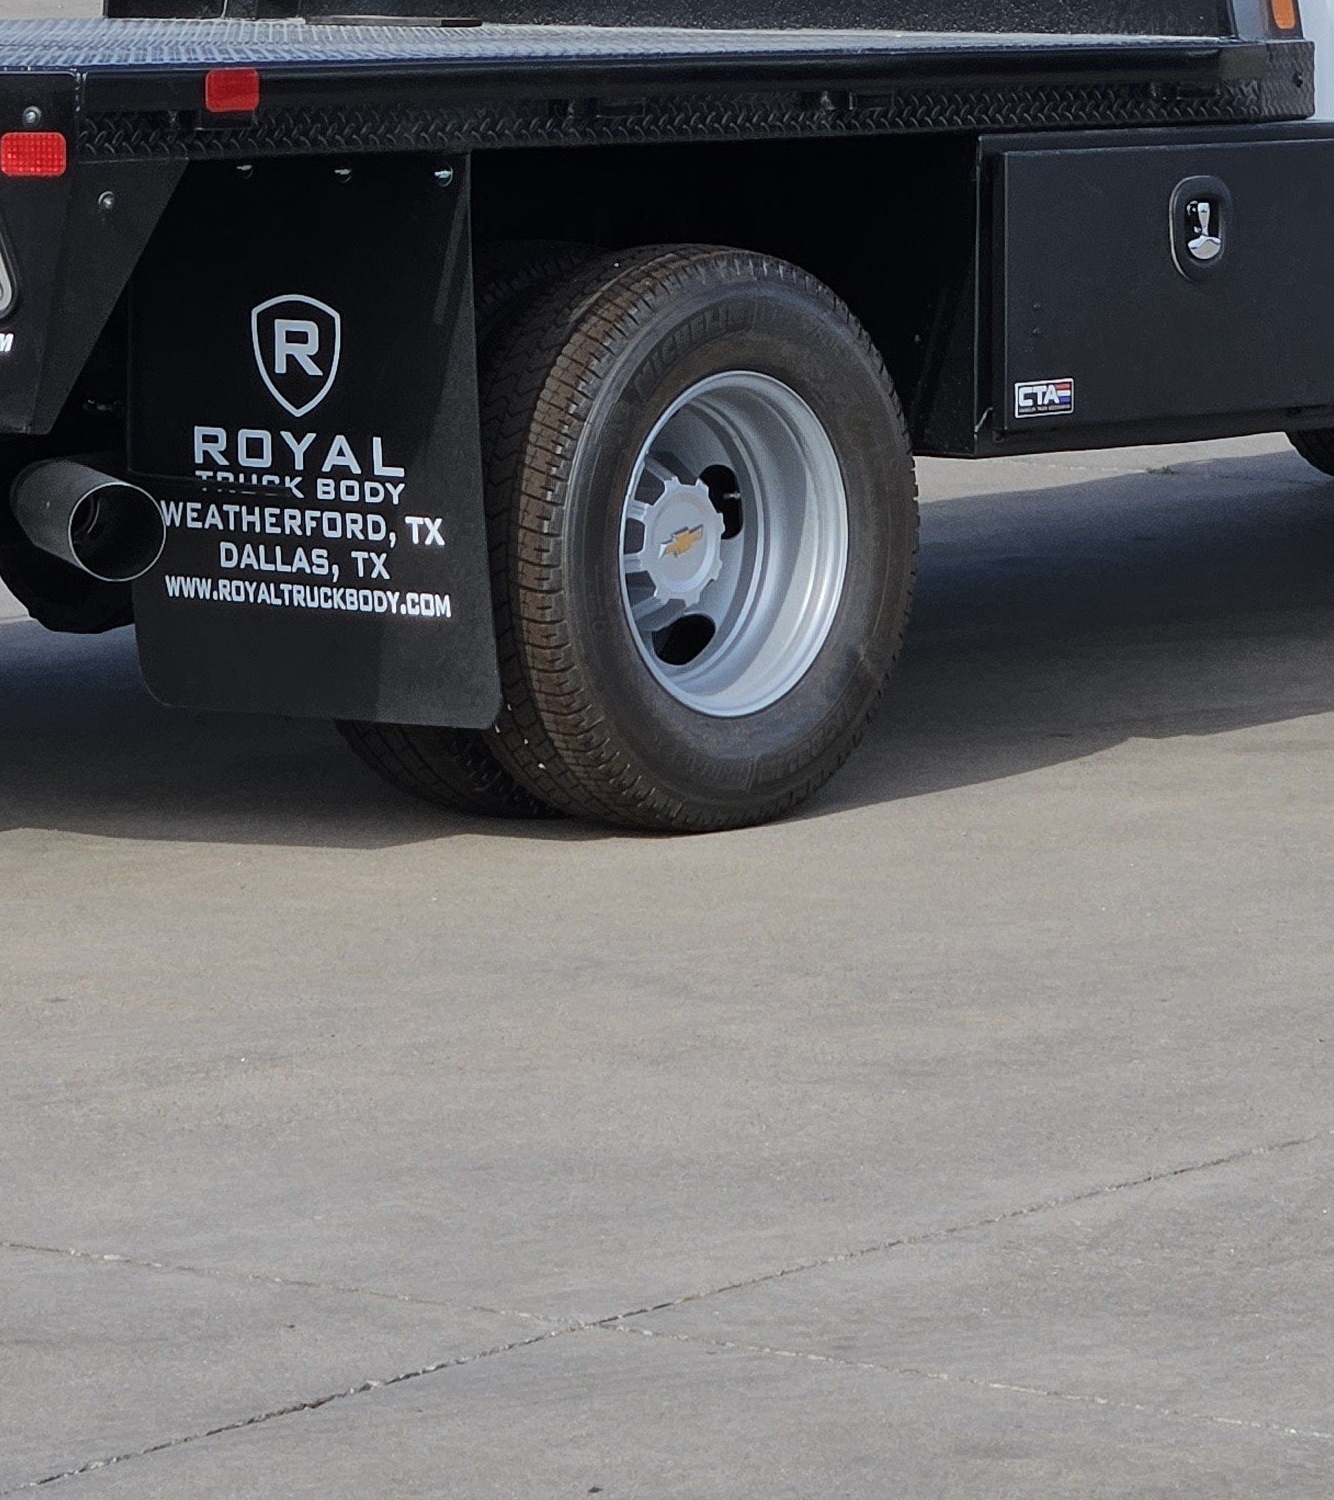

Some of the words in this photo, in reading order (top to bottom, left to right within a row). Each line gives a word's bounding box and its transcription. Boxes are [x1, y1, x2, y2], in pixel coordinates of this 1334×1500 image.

[273, 318, 324, 376] R
[1019, 384, 1061, 407] CTA
[193, 425, 406, 478] ROYAL
[316, 478, 406, 505] BODY
[160, 500, 397, 548] WEATHERFORD,
[404, 515, 446, 547] TX
[219, 541, 340, 582] DALLAS,
[351, 550, 391, 580] TX
[165, 575, 452, 618] WWW.ROYALTRUCKBODY.COM
